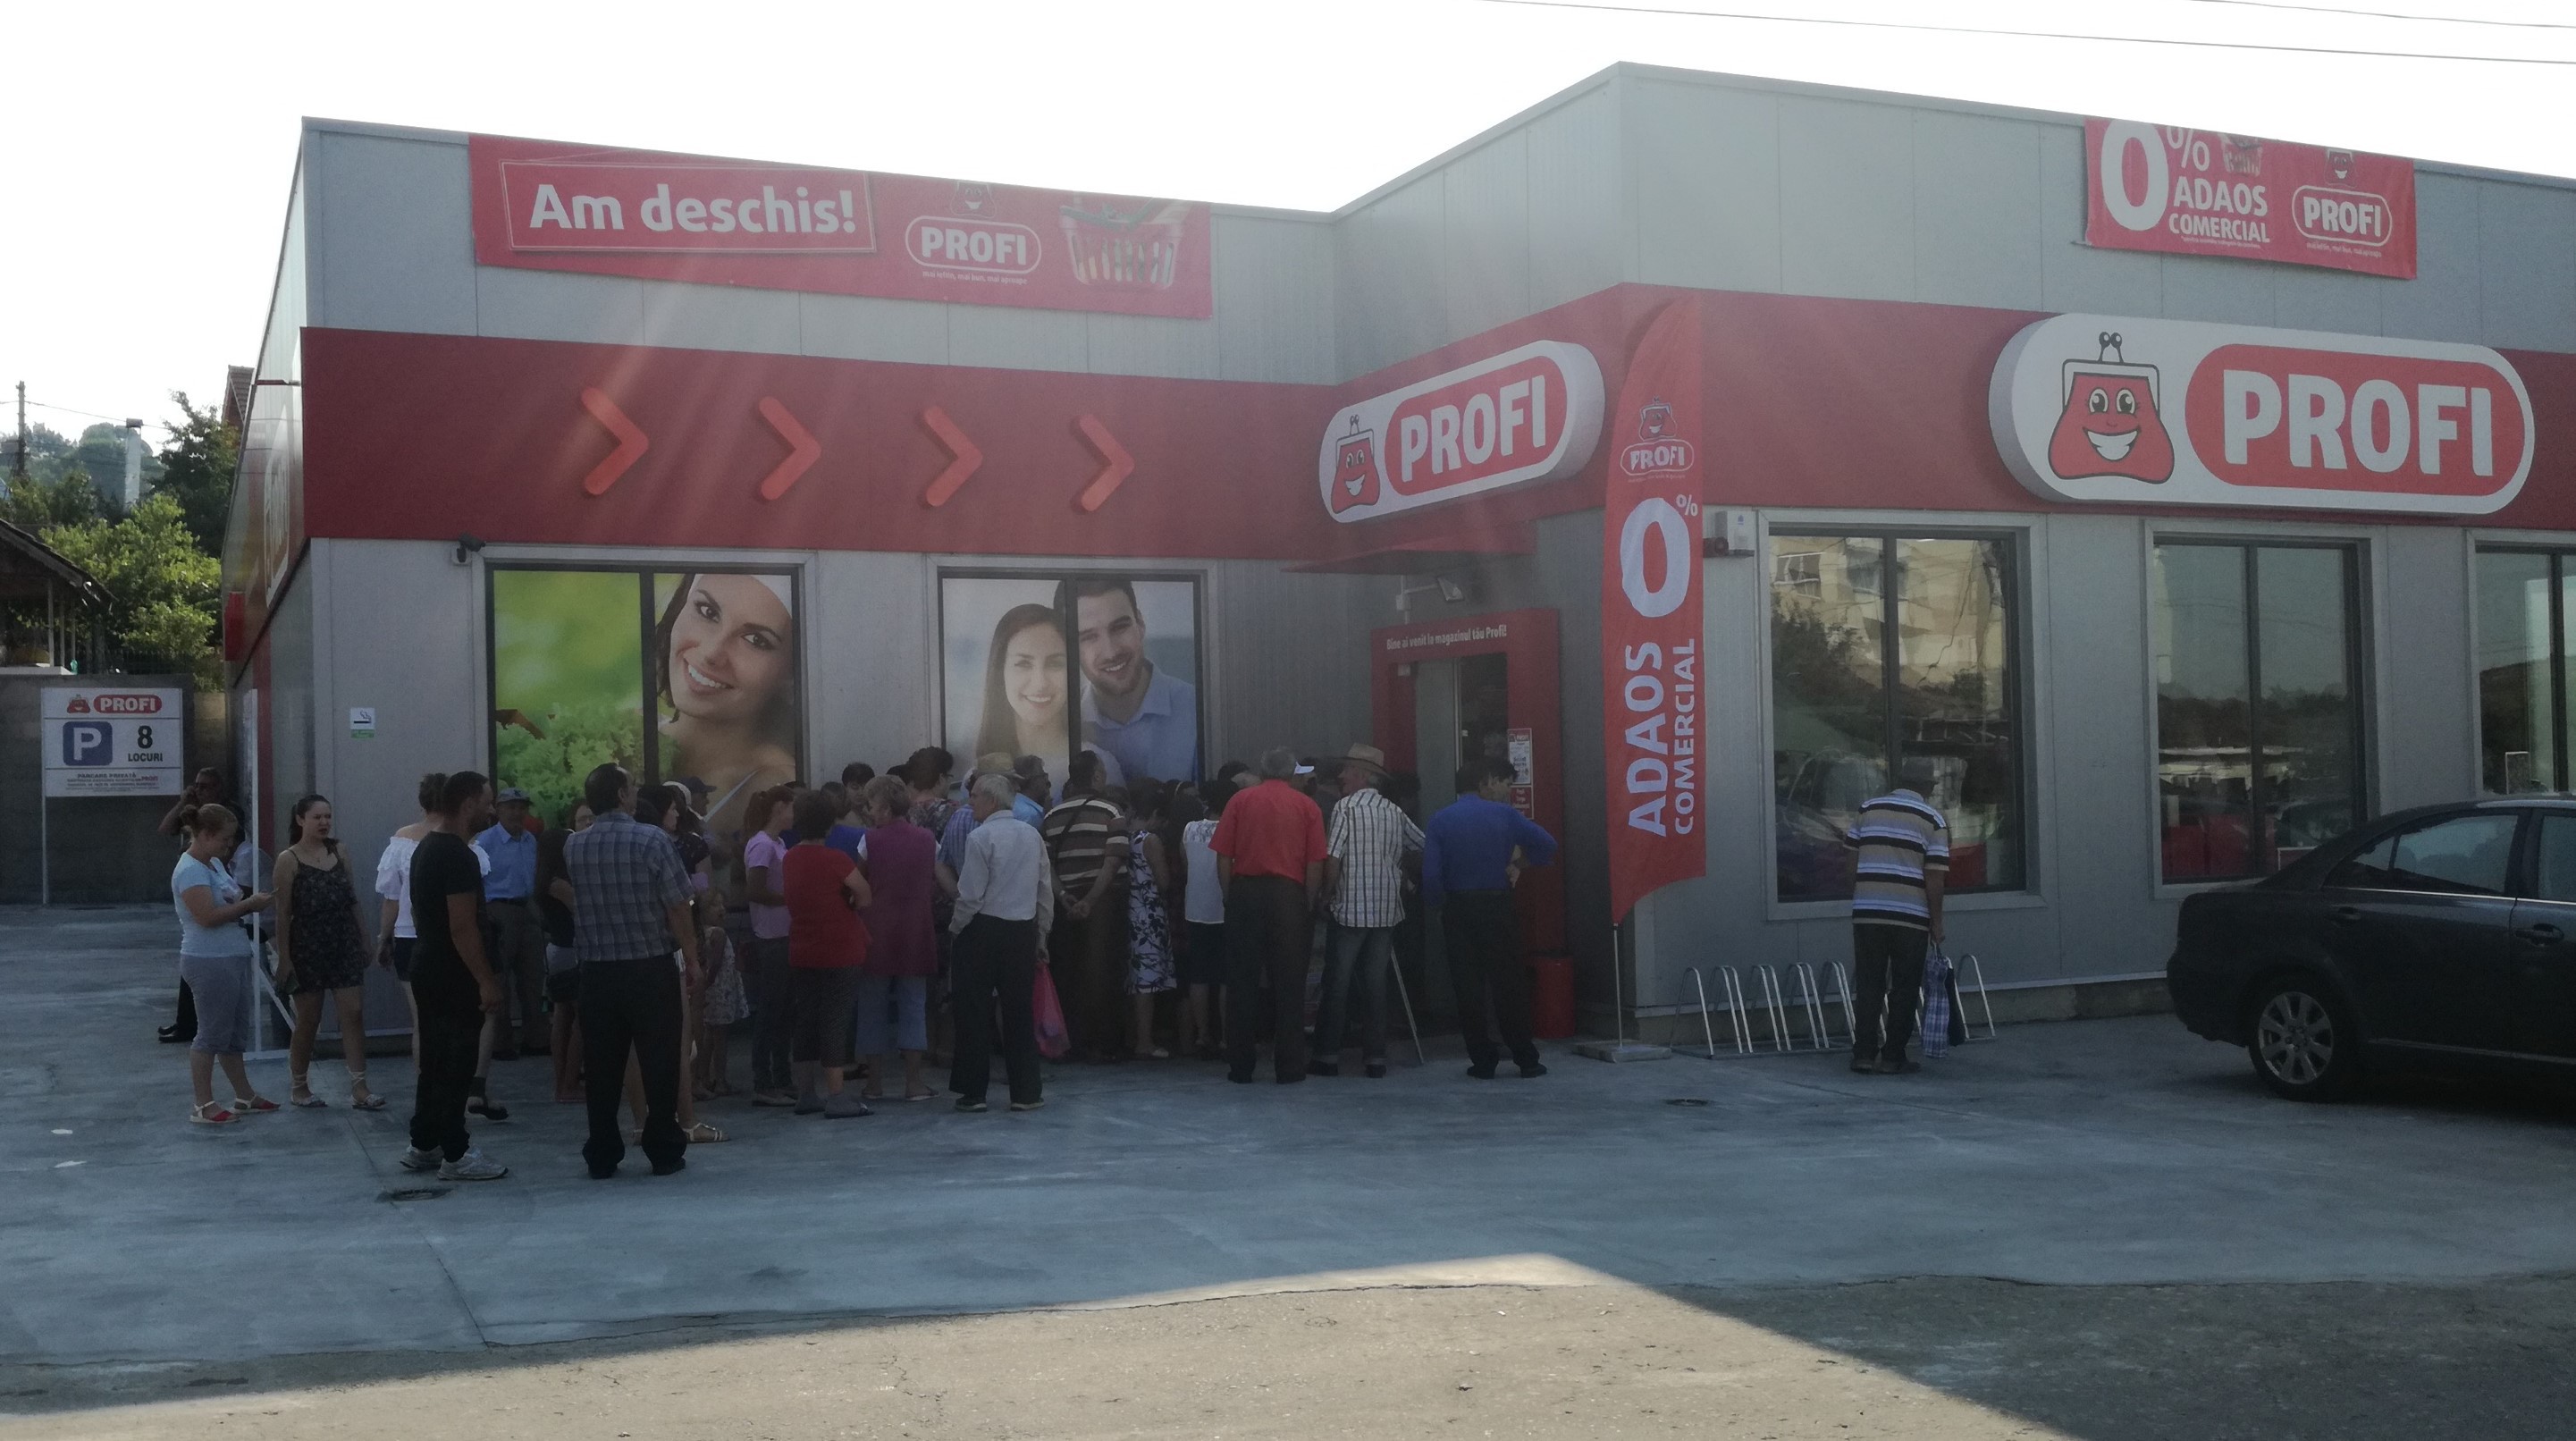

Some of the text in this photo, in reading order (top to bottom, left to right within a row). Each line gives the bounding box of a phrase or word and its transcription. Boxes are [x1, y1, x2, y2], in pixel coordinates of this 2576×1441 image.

[529, 183, 855, 233] Am deschis!
[2173, 176, 2269, 216] ADAOS
[2168, 213, 2270, 243] COMERCIAL
[2303, 196, 2381, 237] PROFI
[921, 226, 1026, 265] PROFI
[1401, 375, 1546, 483] PROFI
[2223, 368, 2493, 477] PROFI
[1630, 445, 1685, 471] PROFI
[1402, 636, 1409, 648] ai
[1410, 635, 1427, 647] venit
[1435, 629, 1471, 646] magazinul
[1486, 624, 1507, 639] Profi!
[100, 697, 156, 712] PROFI
[73, 727, 102, 761] P
[138, 725, 153, 749] 8
[1624, 641, 1669, 838] ADAOS
[1673, 638, 1696, 837] COMERCIAL
[128, 753, 164, 763] LOCURI
